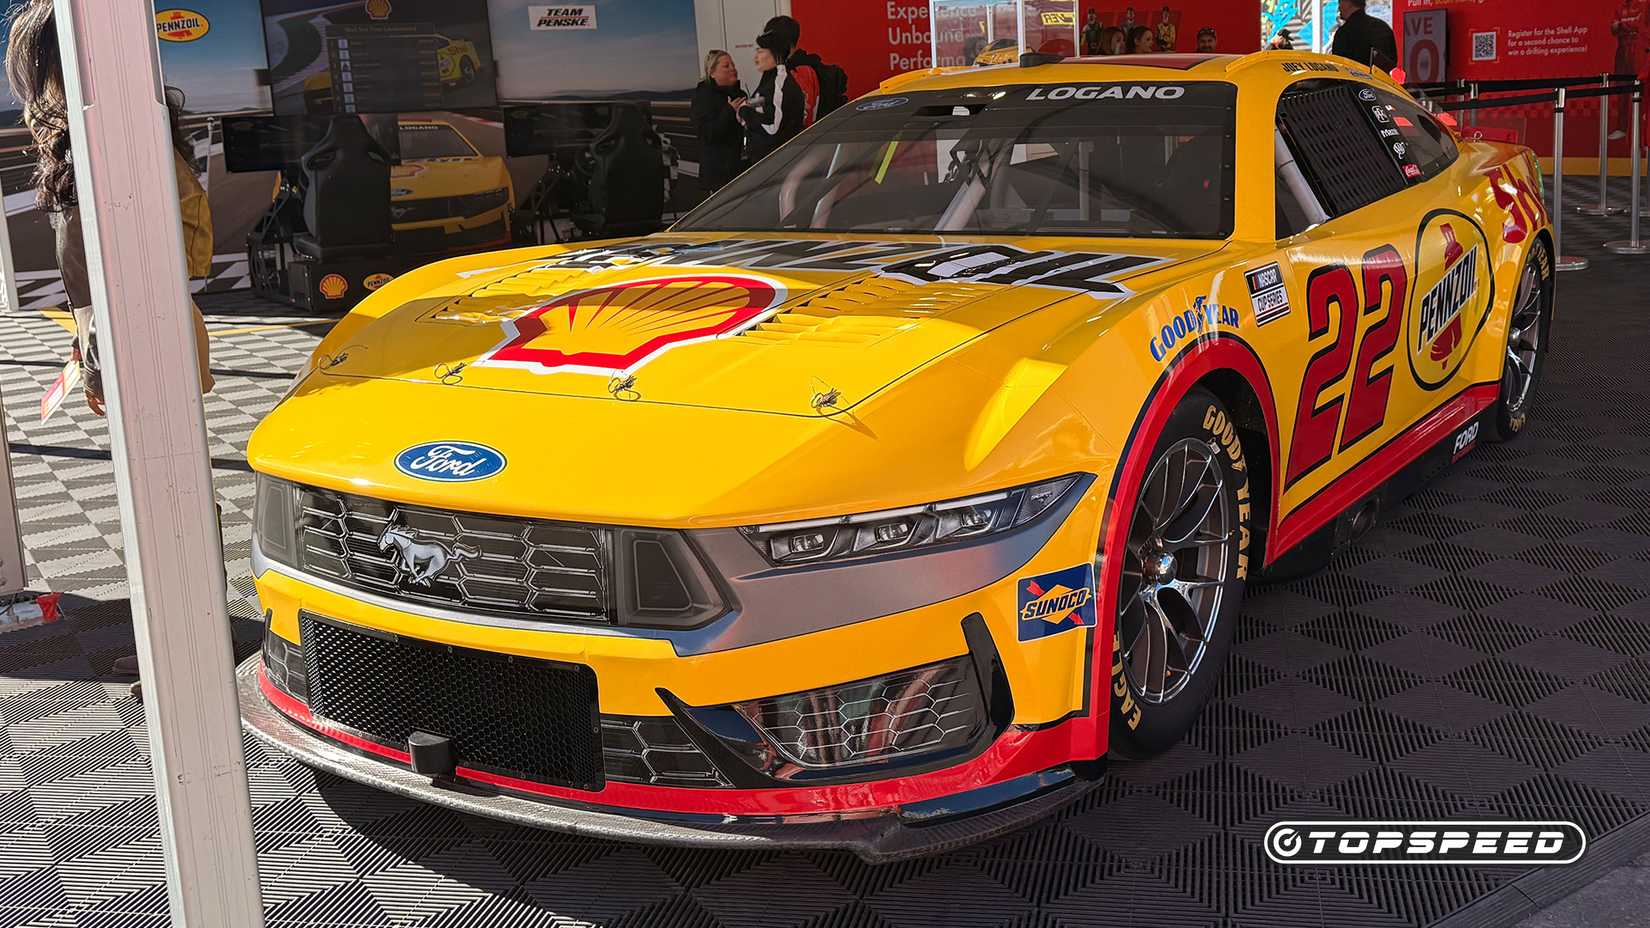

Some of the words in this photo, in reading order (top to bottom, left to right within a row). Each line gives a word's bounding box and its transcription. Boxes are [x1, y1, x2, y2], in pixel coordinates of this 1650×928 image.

[156, 18, 200, 32] PENNZOIL
[537, 17, 588, 27] PENSKE
[547, 8, 584, 16] TEAM
[887, 1, 977, 24] Expeence
[1281, 62, 1305, 73] JOEY
[1026, 86, 1185, 101] LOGANO
[1418, 245, 1478, 353] PENNZOIL
[1150, 299, 1239, 362] GOODYEAR
[1283, 243, 1407, 495] 22
[1453, 421, 1479, 454] FORD
[410, 445, 487, 476] Ford
[1203, 404, 1250, 581] GOODYEAR
[1023, 590, 1088, 619] SUNOCO
